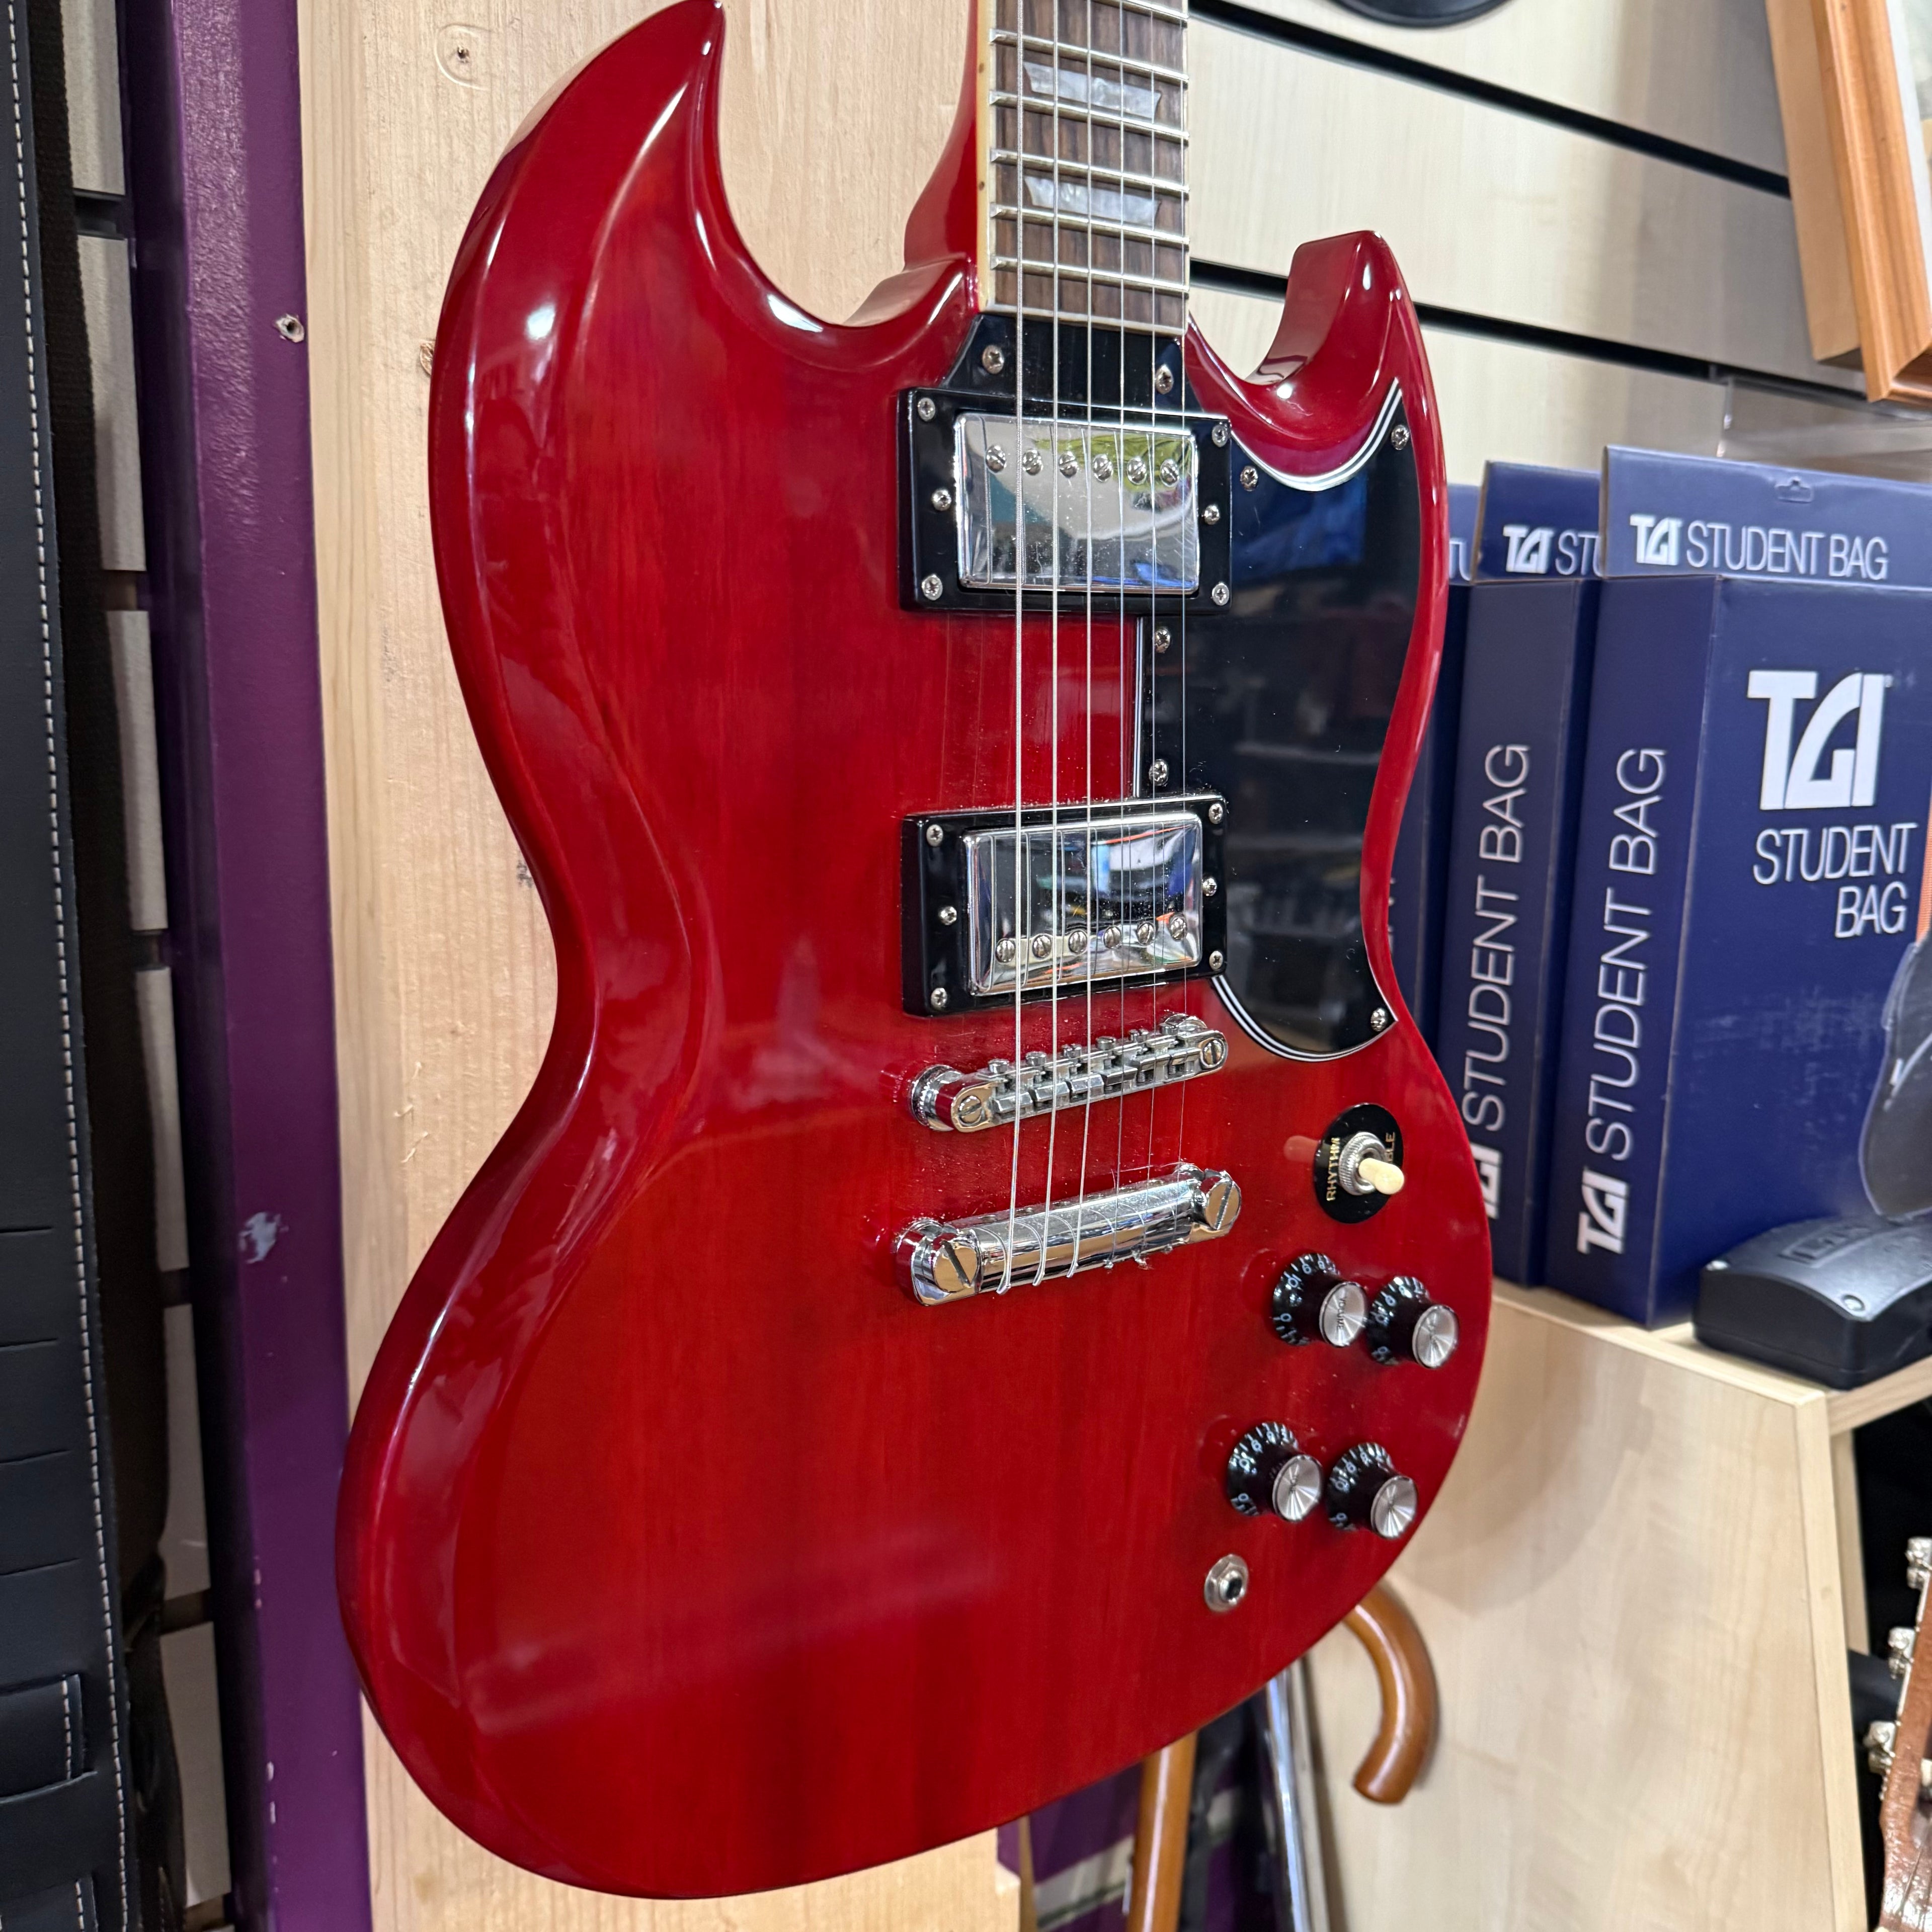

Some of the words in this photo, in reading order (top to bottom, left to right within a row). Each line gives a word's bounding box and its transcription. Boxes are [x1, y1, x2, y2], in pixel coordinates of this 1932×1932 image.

[1686, 520, 1824, 575] STUDENT
[1828, 535, 1888, 581] BAG
[1480, 744, 1530, 862] BAG
[1609, 748, 1667, 875] BAG
[1753, 823, 1918, 884] STUDENT
[1834, 881, 1907, 938] BAG
[1462, 875, 1519, 1132] STUDENT
[1585, 888, 1652, 1161] STUDENT
[1326, 1137, 1340, 1201] RHYTHM
